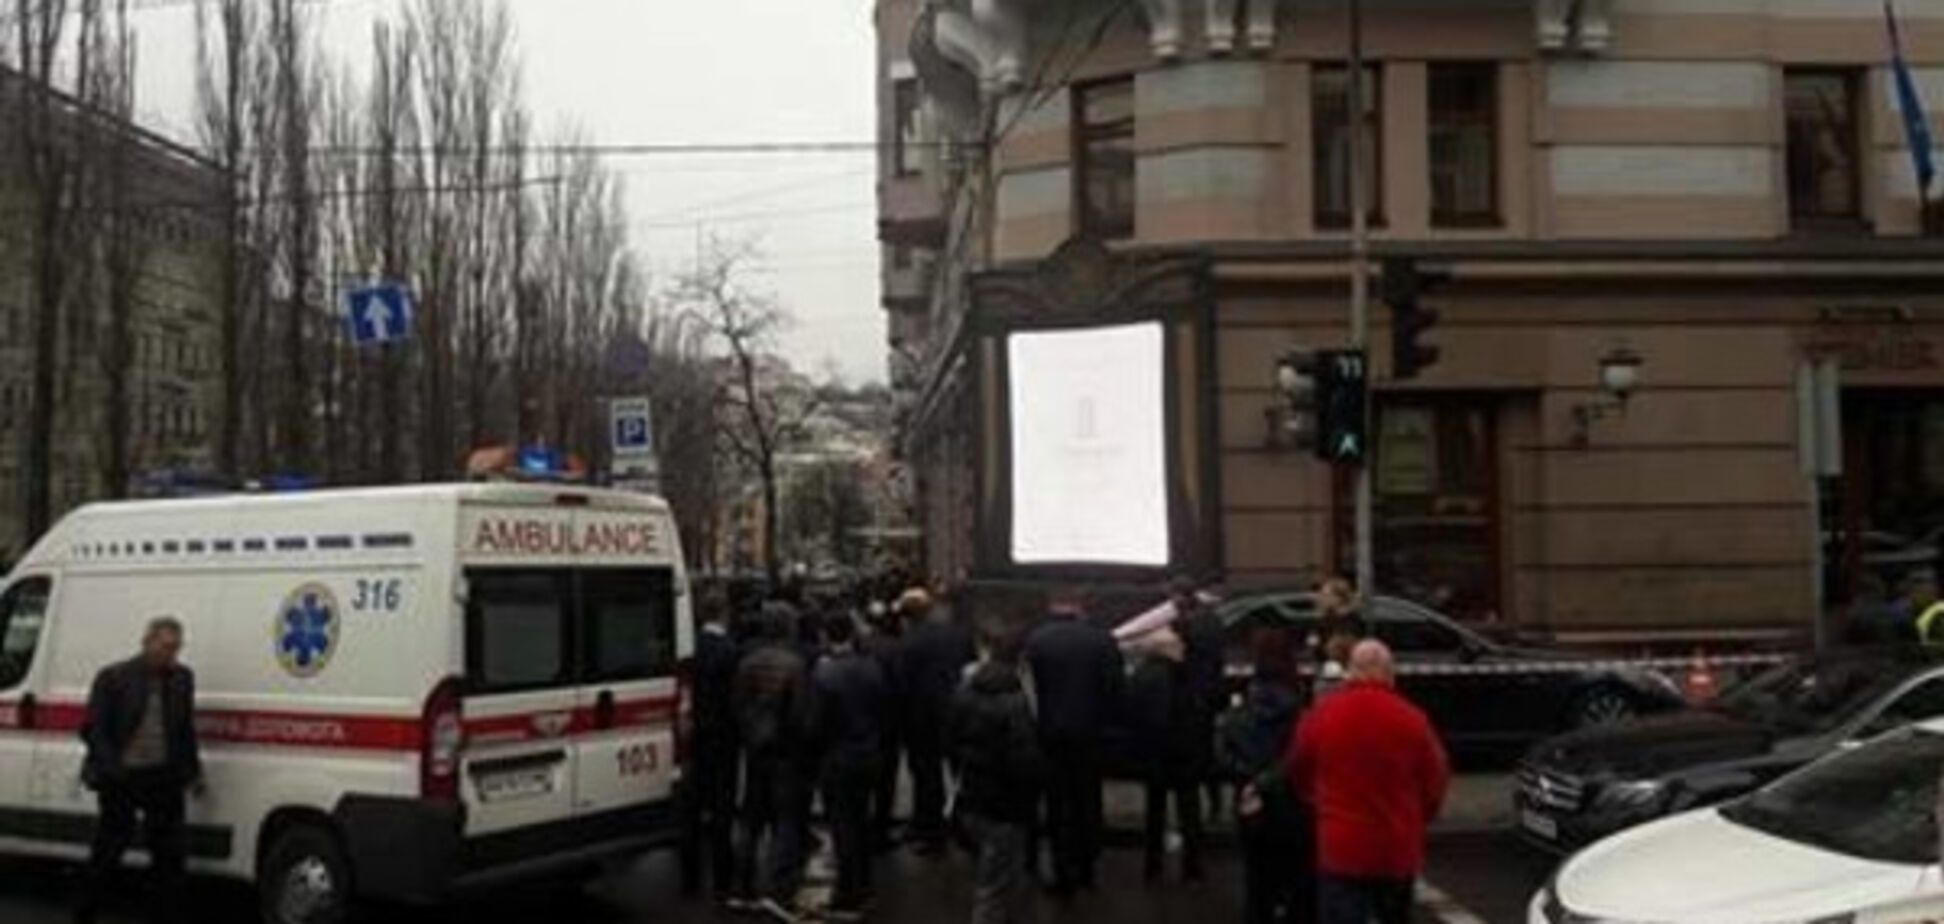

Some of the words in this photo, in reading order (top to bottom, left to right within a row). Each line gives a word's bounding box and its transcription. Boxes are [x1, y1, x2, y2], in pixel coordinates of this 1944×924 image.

[623, 417, 642, 444] P
[475, 518, 657, 553] AMBULANCE
[351, 578, 402, 611] 316
[616, 742, 658, 776] 103
